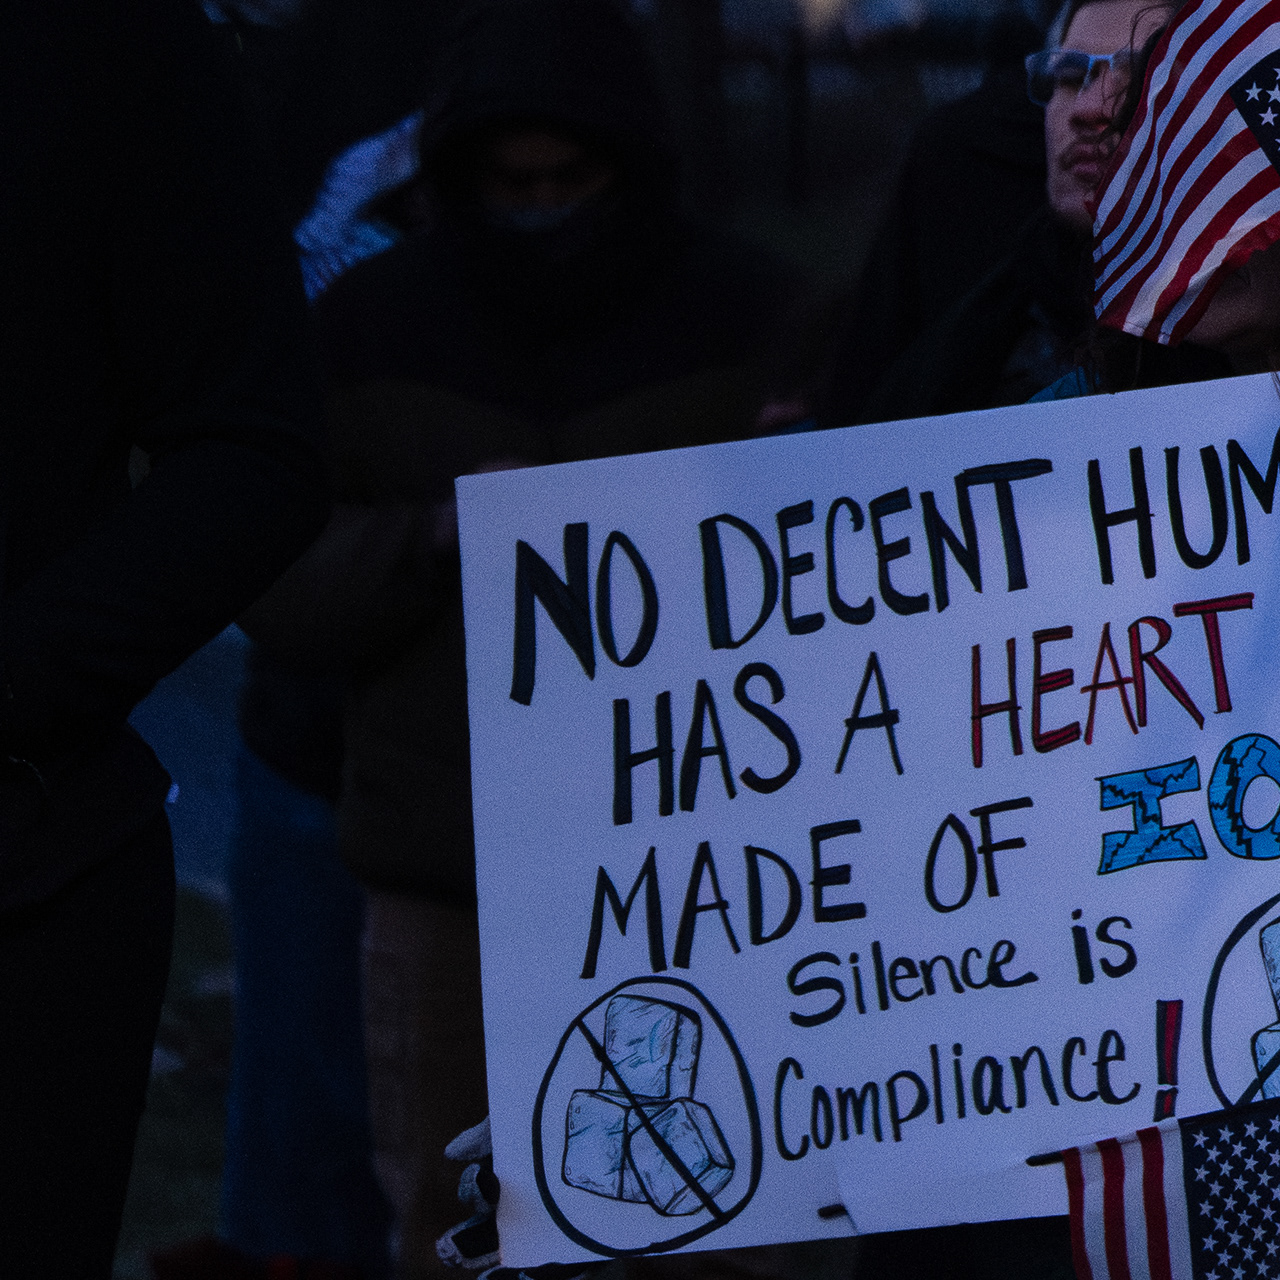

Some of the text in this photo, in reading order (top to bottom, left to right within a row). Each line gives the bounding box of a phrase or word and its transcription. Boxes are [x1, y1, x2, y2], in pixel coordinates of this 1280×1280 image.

[511, 522, 658, 705] NO
[700, 458, 1051, 650] DECENT
[613, 592, 1255, 825] HAS A HEART
[581, 818, 867, 979] MADE
[924, 796, 1035, 913] OF
[789, 909, 1137, 1026] Silence is
[774, 998, 1184, 1161] Compliance!
